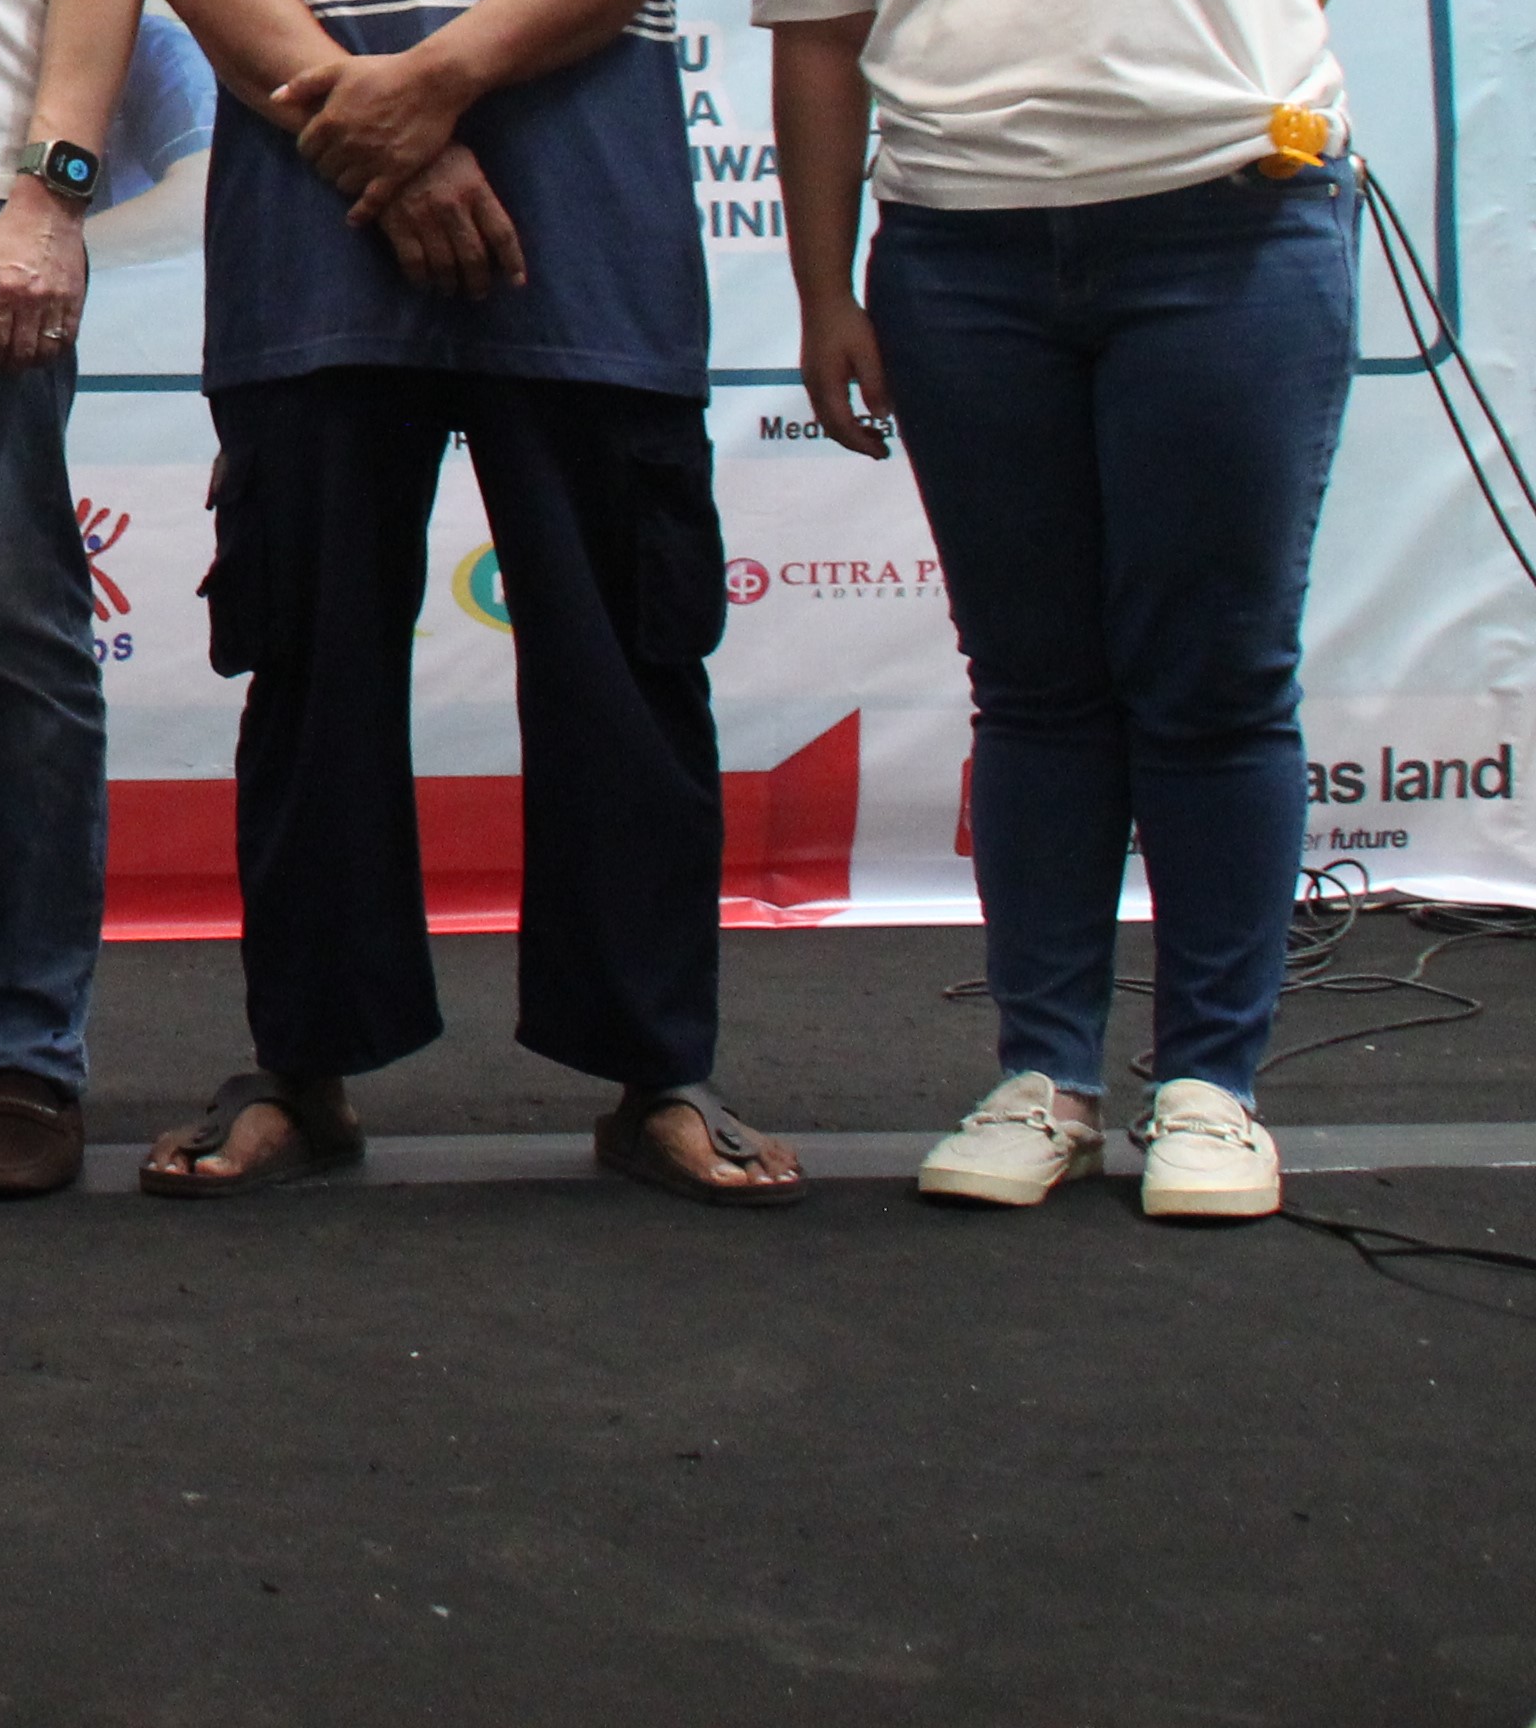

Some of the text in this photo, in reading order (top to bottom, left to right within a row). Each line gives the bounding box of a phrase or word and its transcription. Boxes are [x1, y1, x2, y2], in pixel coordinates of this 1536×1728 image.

[780, 560, 901, 586] CITRA
[1380, 744, 1513, 803] land
[1330, 828, 1408, 852] future
